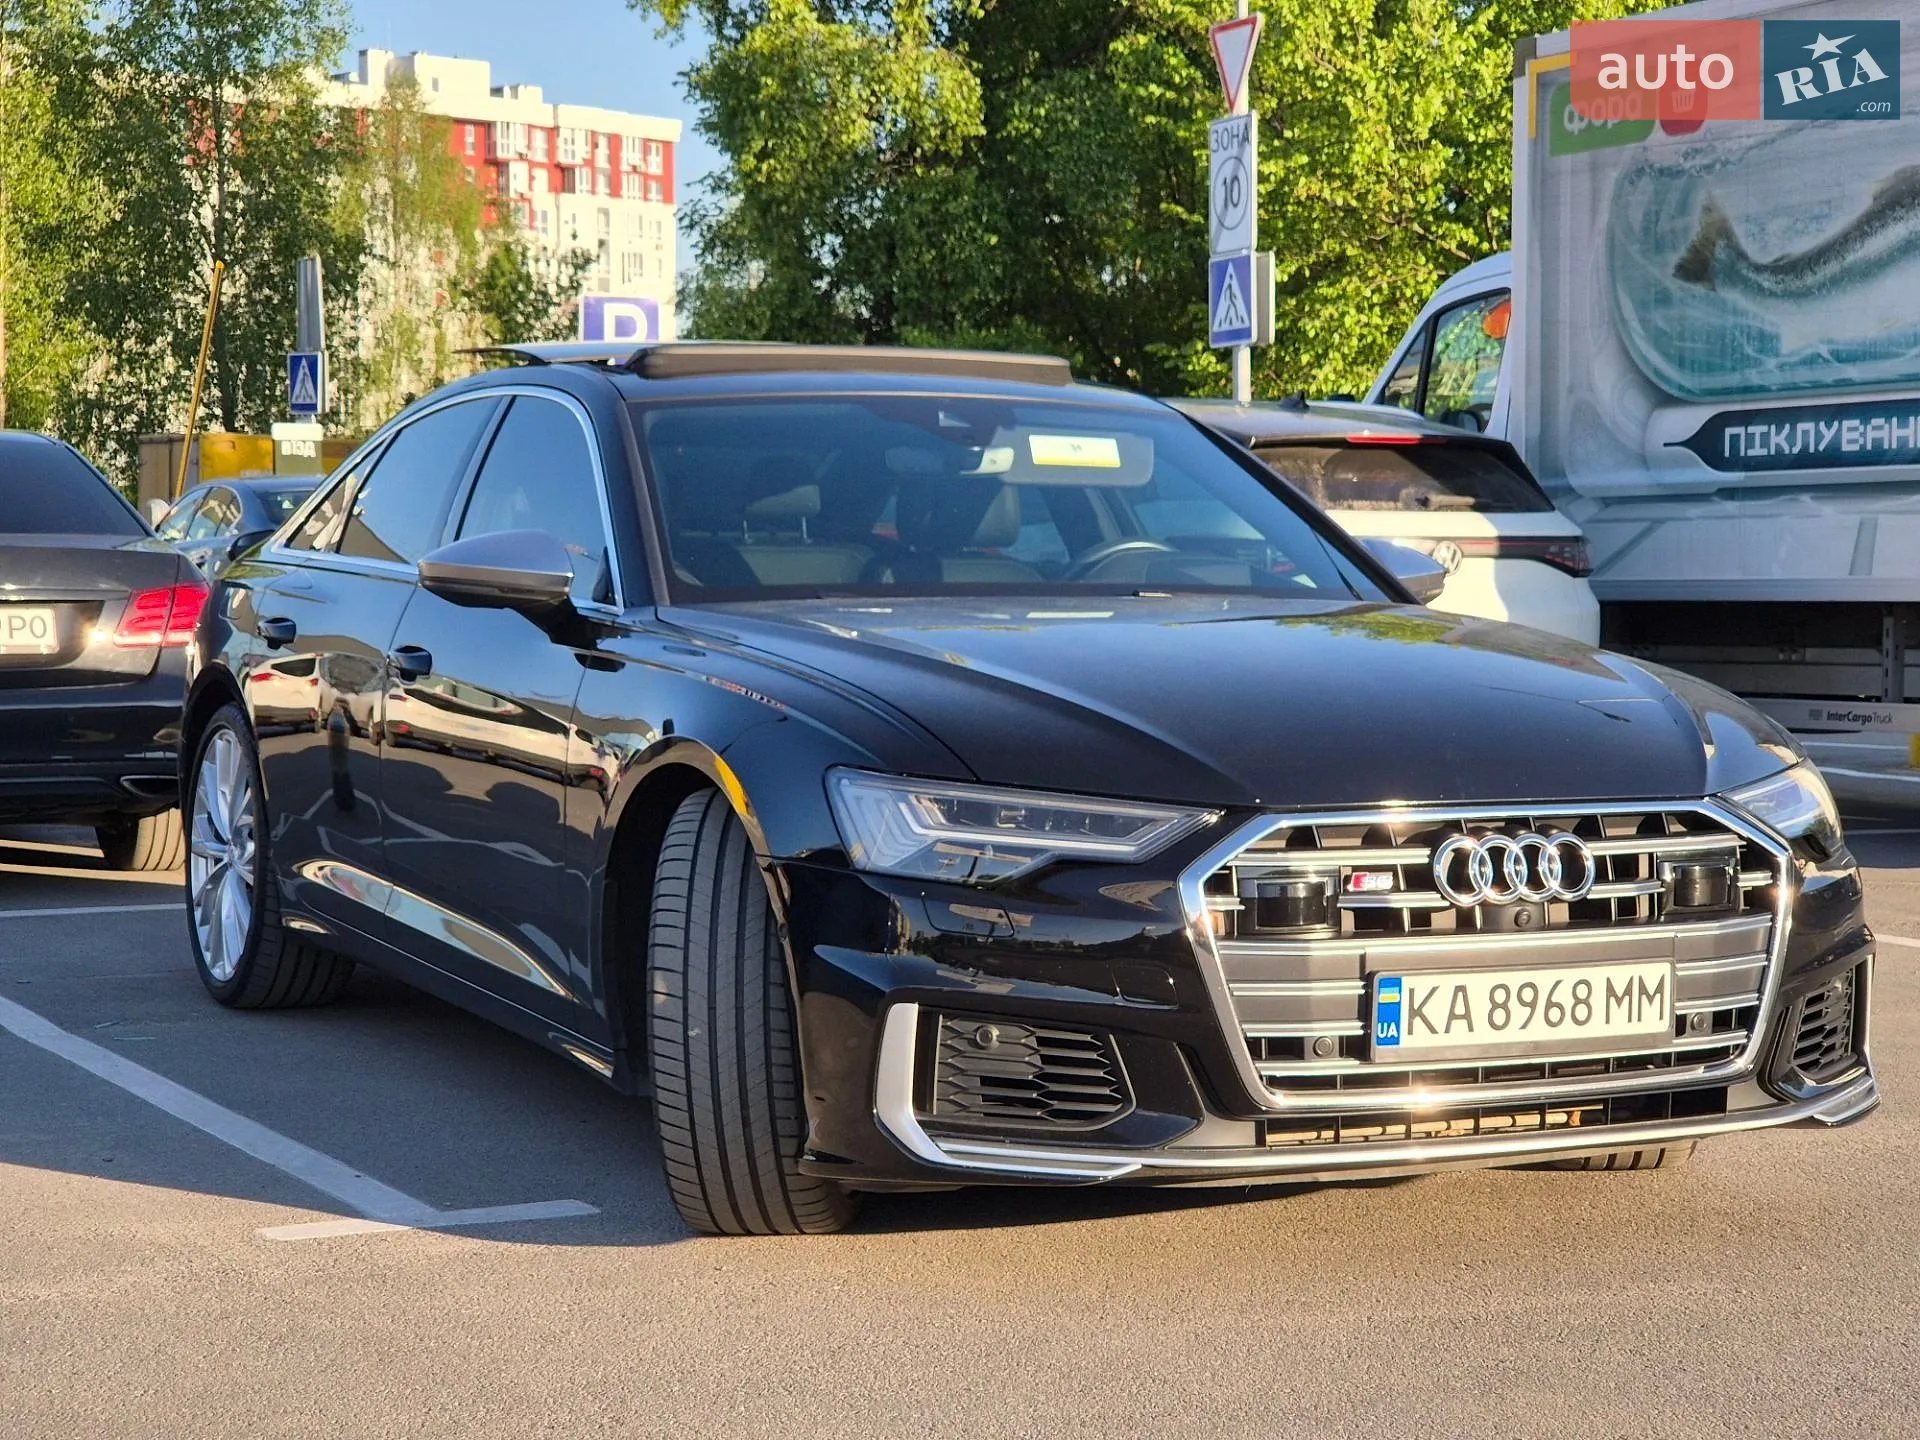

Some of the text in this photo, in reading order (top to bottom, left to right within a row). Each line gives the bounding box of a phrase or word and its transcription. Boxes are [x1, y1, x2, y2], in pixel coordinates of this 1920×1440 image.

[1210, 123, 1250, 153] ЗОНА
[1221, 175, 1241, 211] 10
[1724, 415, 1920, 458] ПІКЛУВАН
[1407, 974, 1666, 1035] KA 8968 MM
[1377, 1021, 1399, 1039] UA
